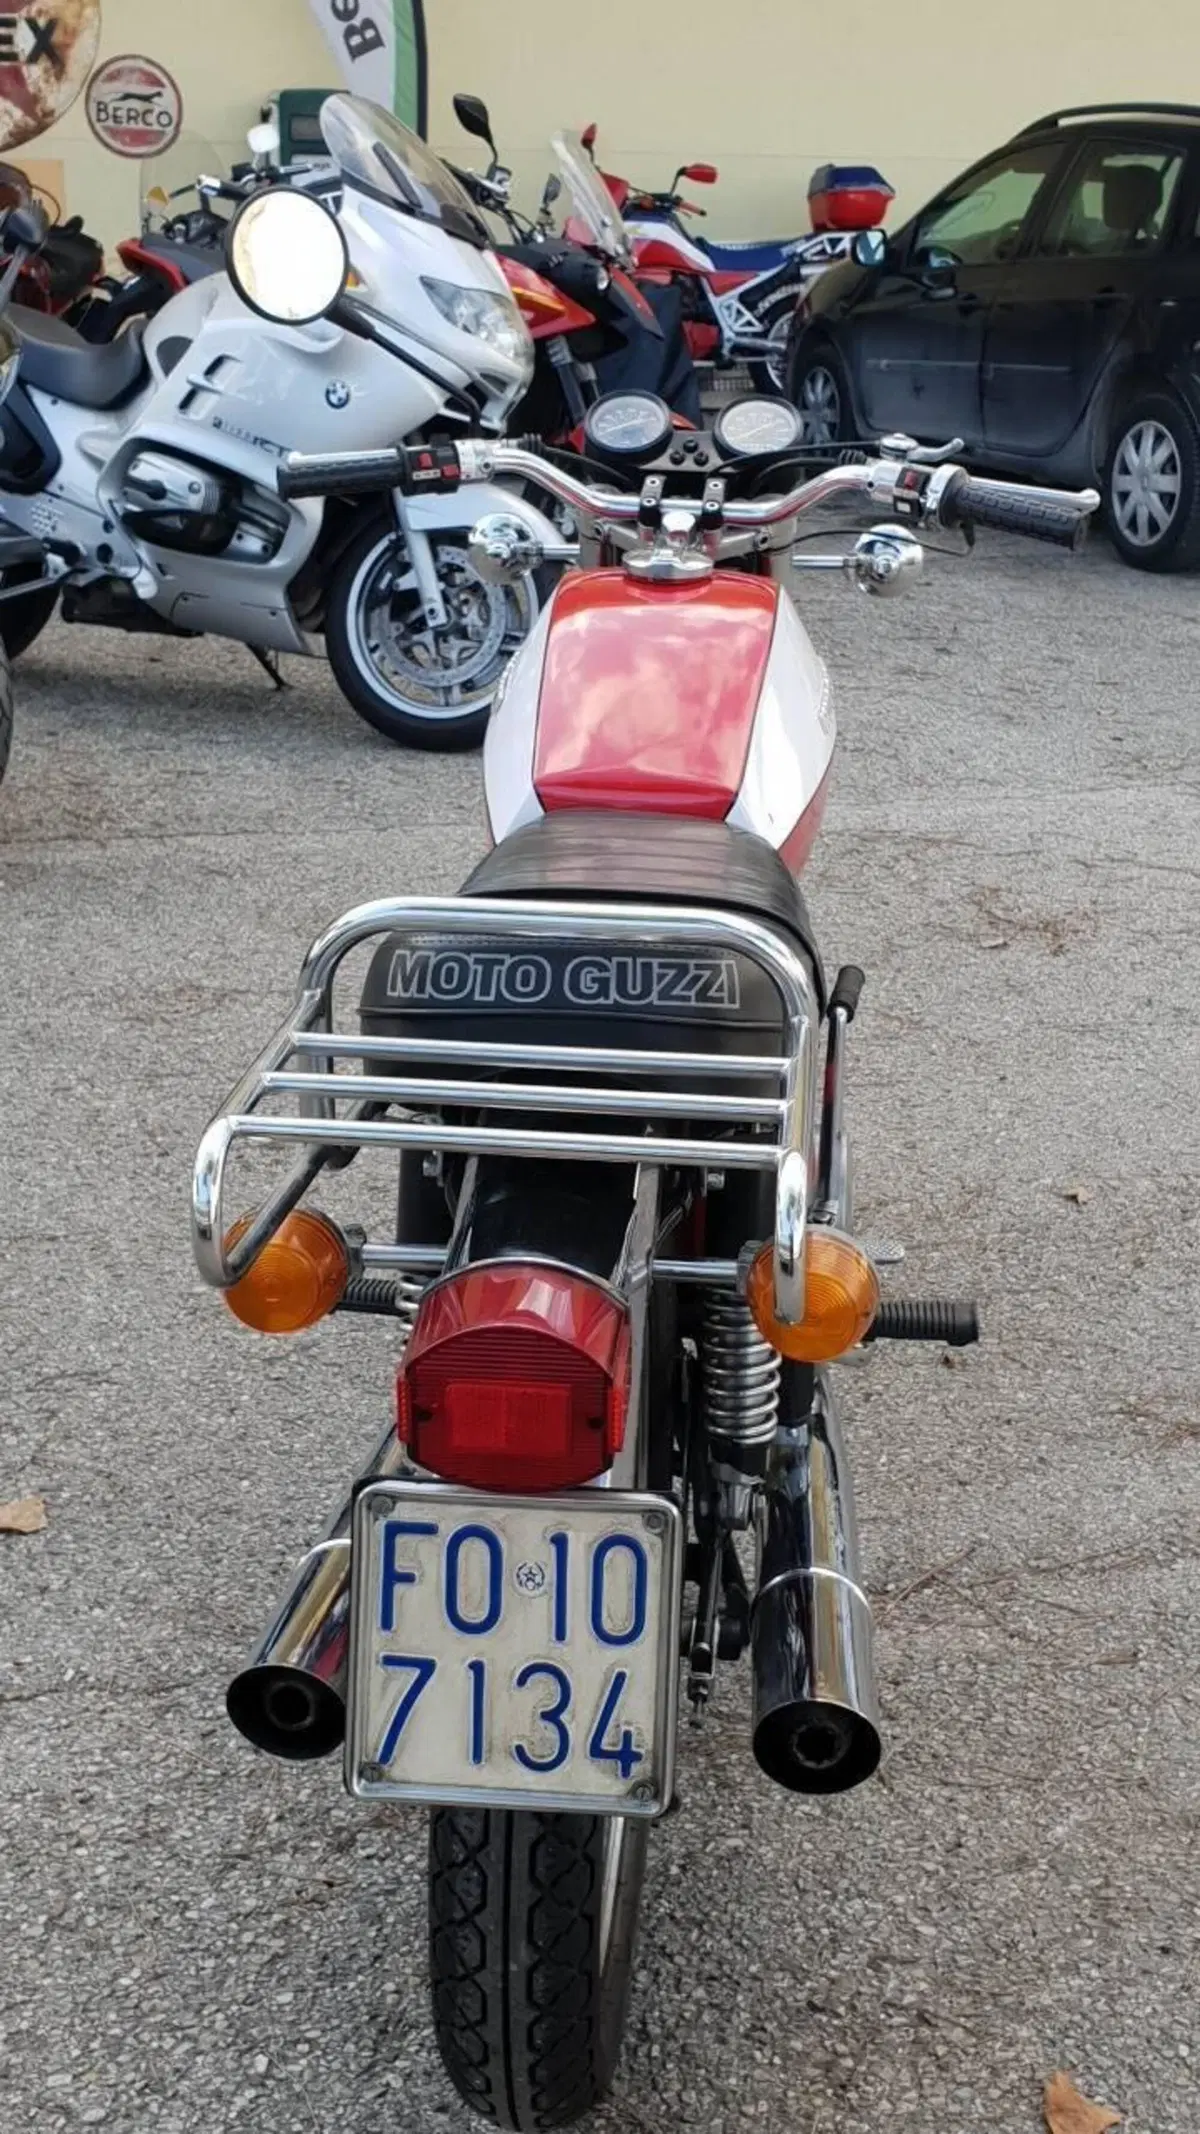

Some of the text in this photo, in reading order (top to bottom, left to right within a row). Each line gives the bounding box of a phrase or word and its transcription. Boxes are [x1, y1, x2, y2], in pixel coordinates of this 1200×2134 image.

[95, 101, 173, 128] BERCO
[387, 950, 741, 1009] MOTO GUZZI
[378, 1655, 643, 1779] 7134
